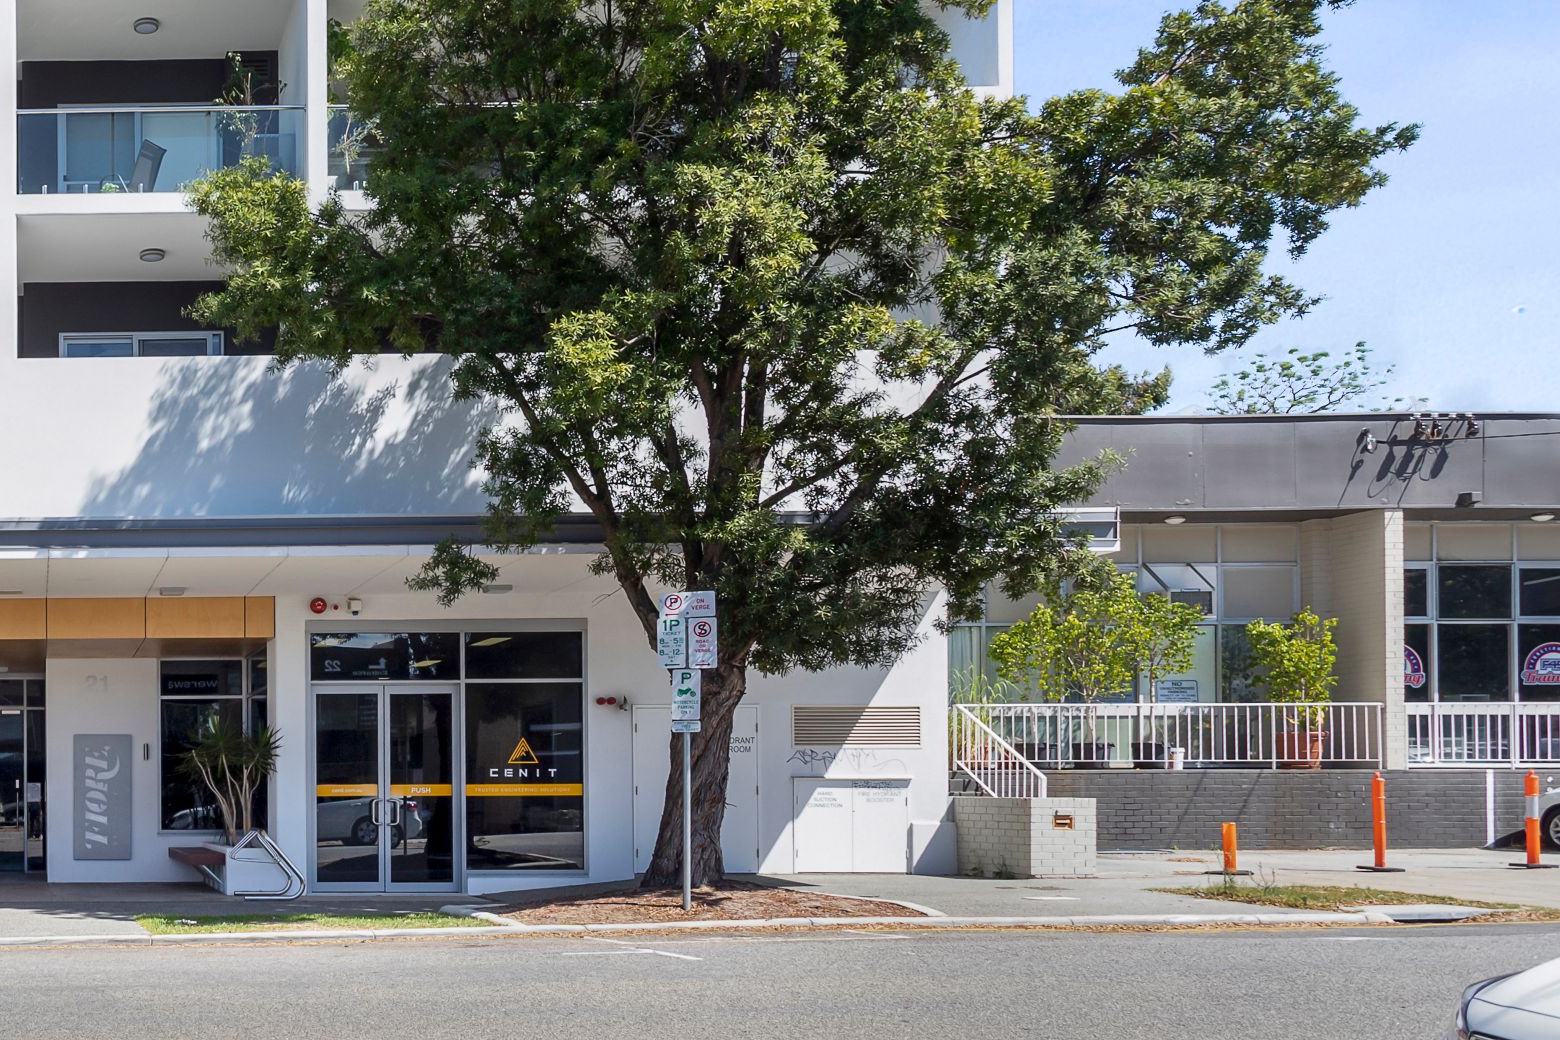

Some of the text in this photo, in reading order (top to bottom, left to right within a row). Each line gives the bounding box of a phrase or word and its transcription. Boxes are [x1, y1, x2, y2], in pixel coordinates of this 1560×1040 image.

[662, 619, 681, 632] 1P
[85, 674, 109, 692] 21
[681, 672, 692, 684] P
[729, 736, 755, 744] DRANT
[489, 768, 558, 778] CENIT
[411, 786, 432, 794] PUSH
[83, 744, 121, 850] FIORE
